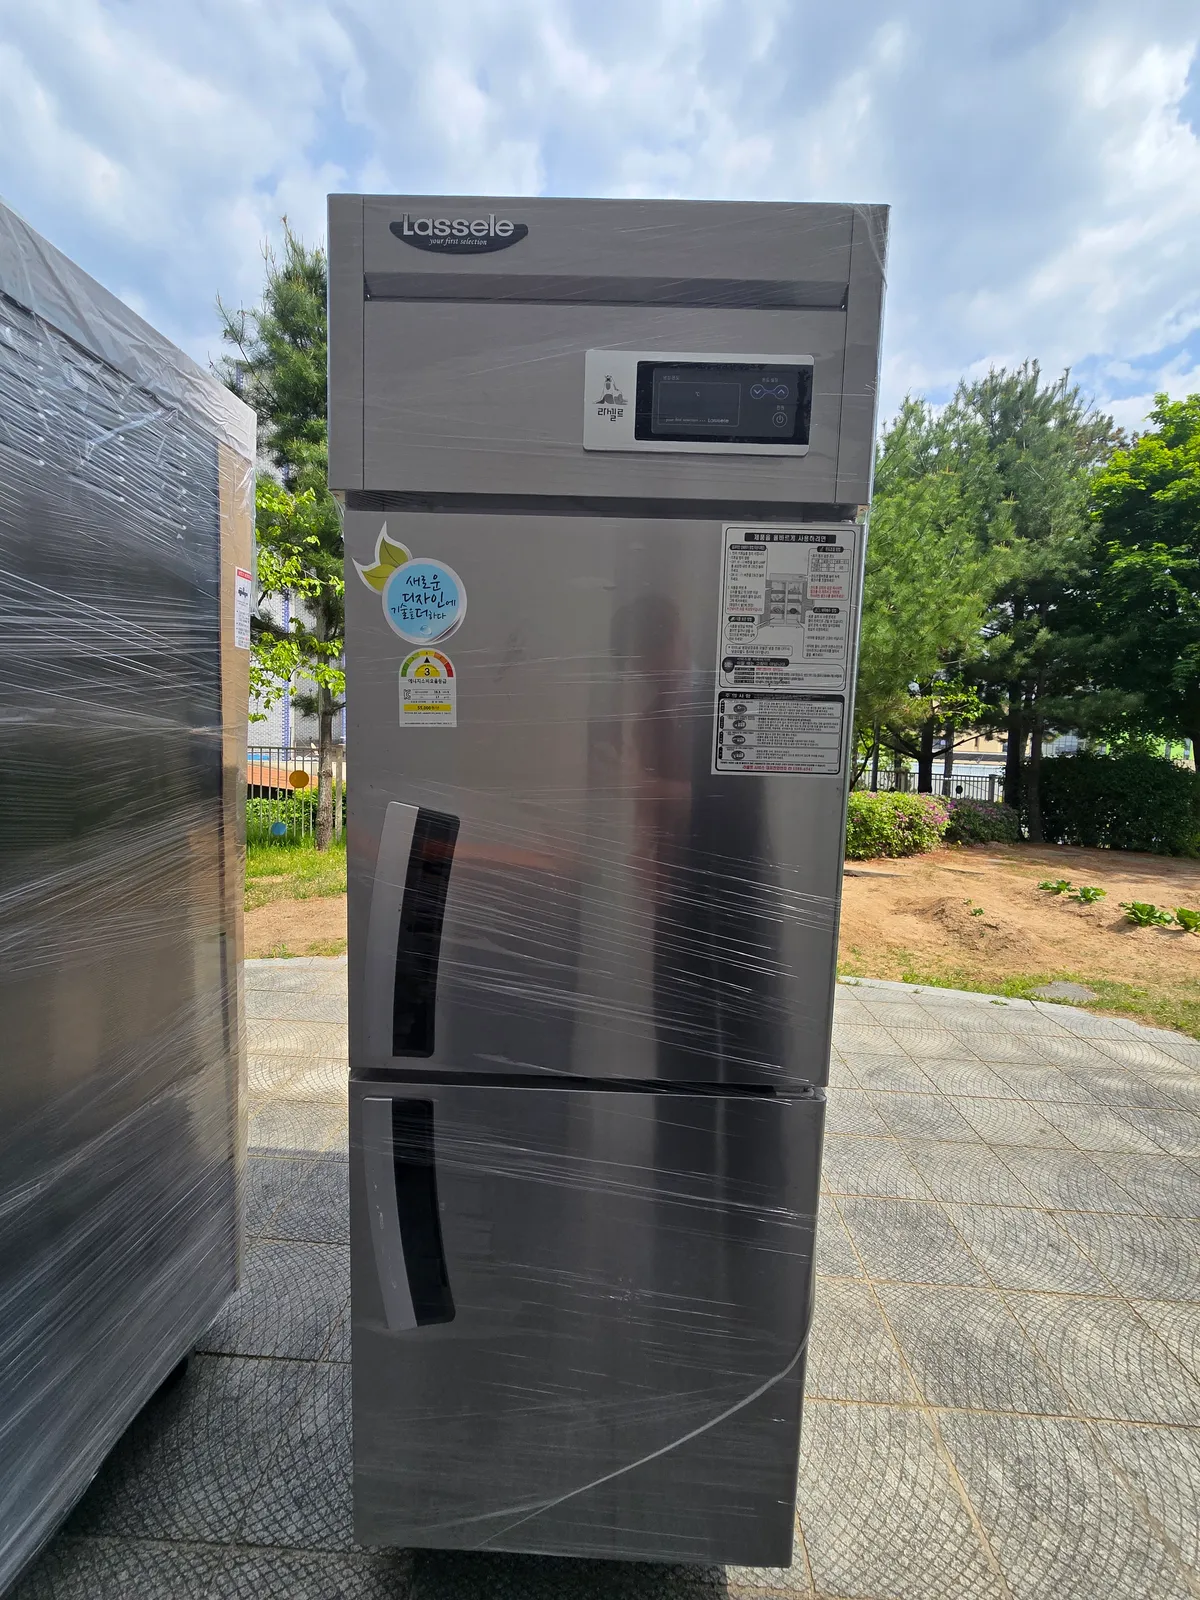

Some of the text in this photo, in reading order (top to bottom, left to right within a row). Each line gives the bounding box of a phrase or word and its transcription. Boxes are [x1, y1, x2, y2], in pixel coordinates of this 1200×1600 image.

[403, 213, 514, 237] Lassele
[429, 237, 487, 246] your first selection
[406, 574, 442, 592] 새로운
[402, 591, 456, 609] 디자인에
[424, 667, 431, 677] 3
